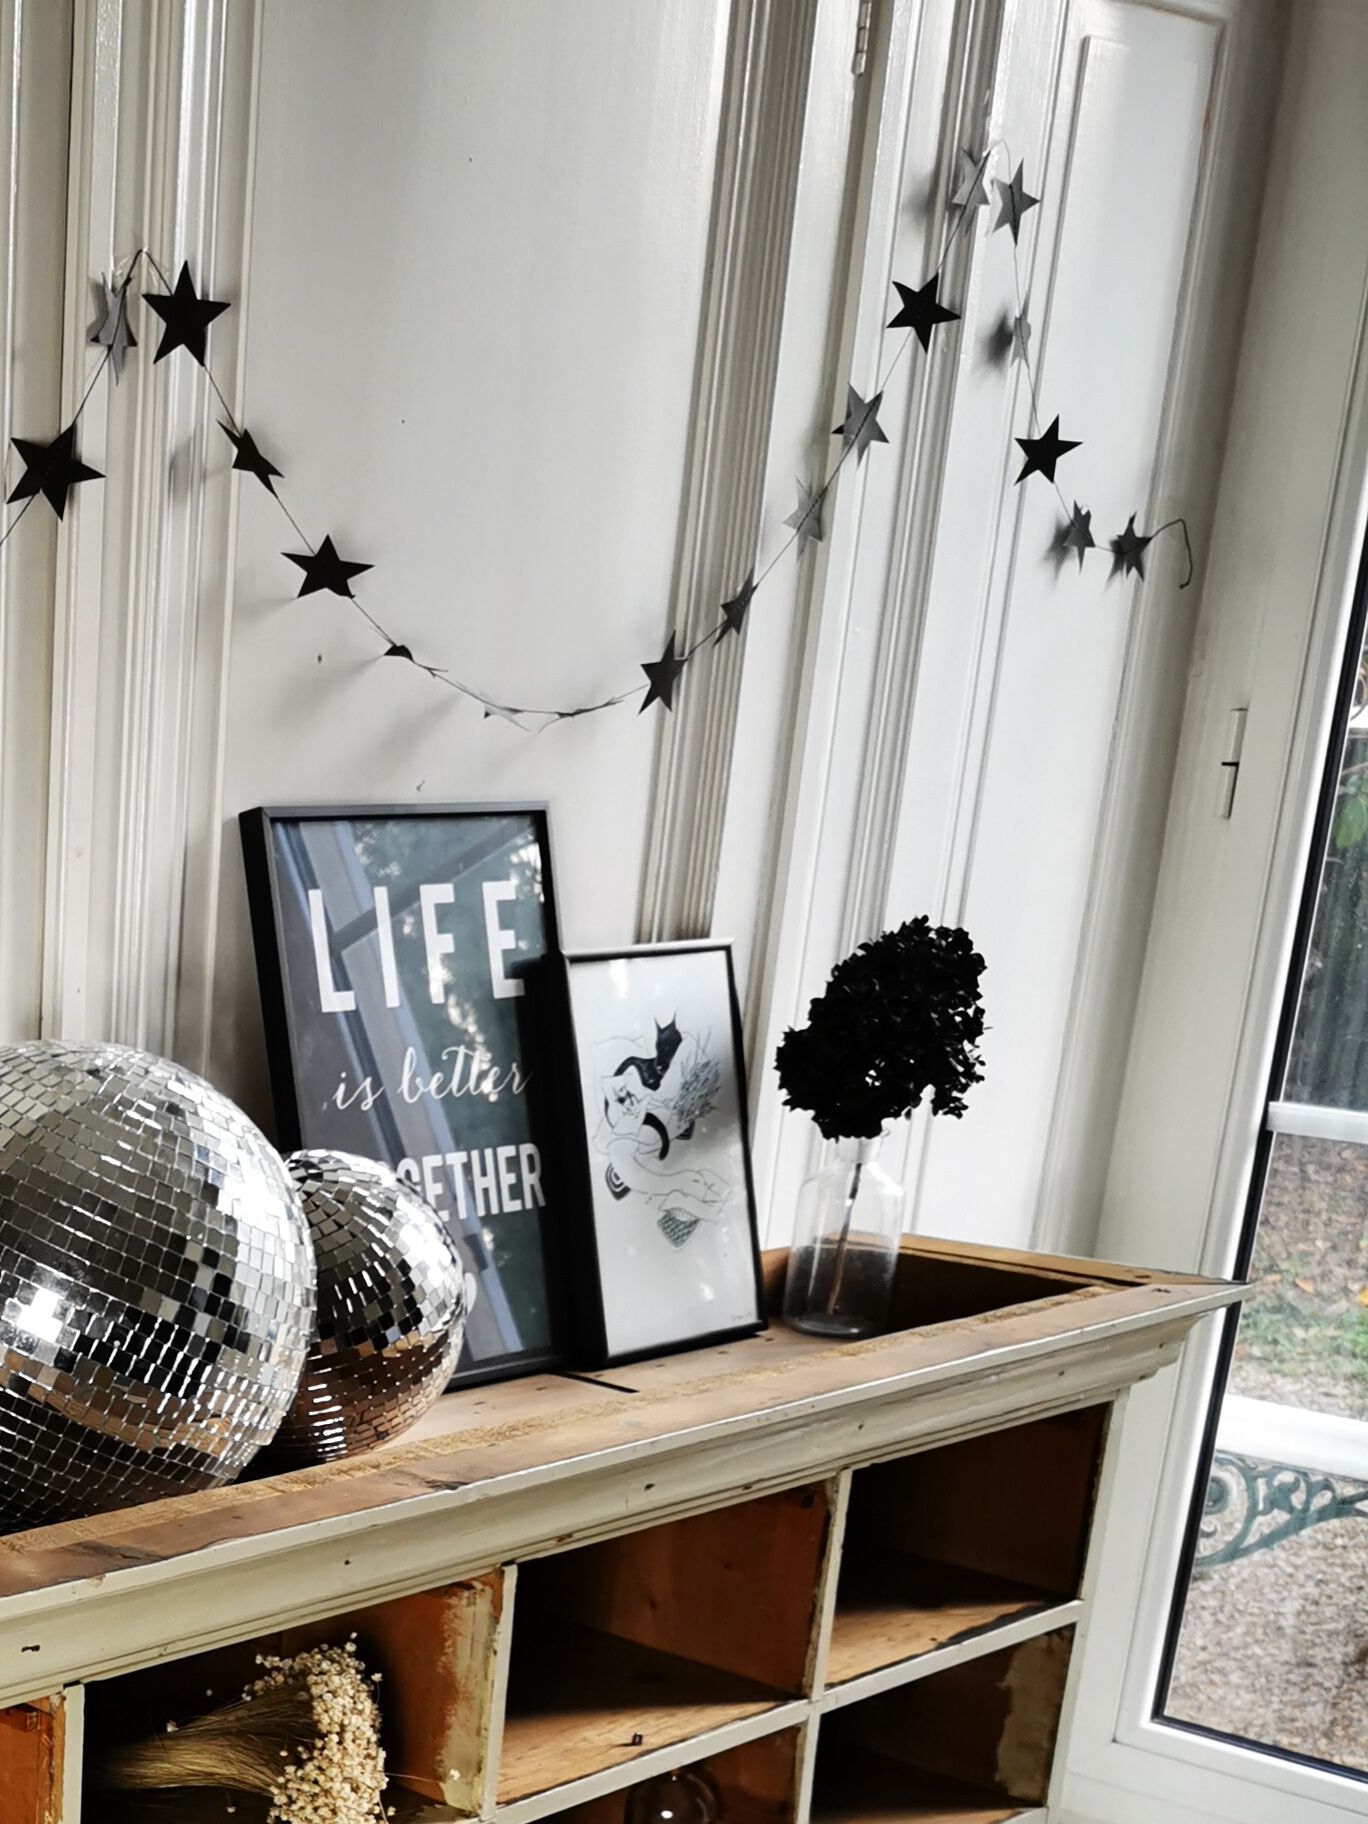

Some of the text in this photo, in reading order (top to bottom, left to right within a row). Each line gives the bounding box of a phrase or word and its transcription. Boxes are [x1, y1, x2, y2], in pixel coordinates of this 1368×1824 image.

[308, 880, 525, 1013] LIFE
[332, 1045, 531, 1110] is better
[396, 1142, 546, 1222] GETHER
